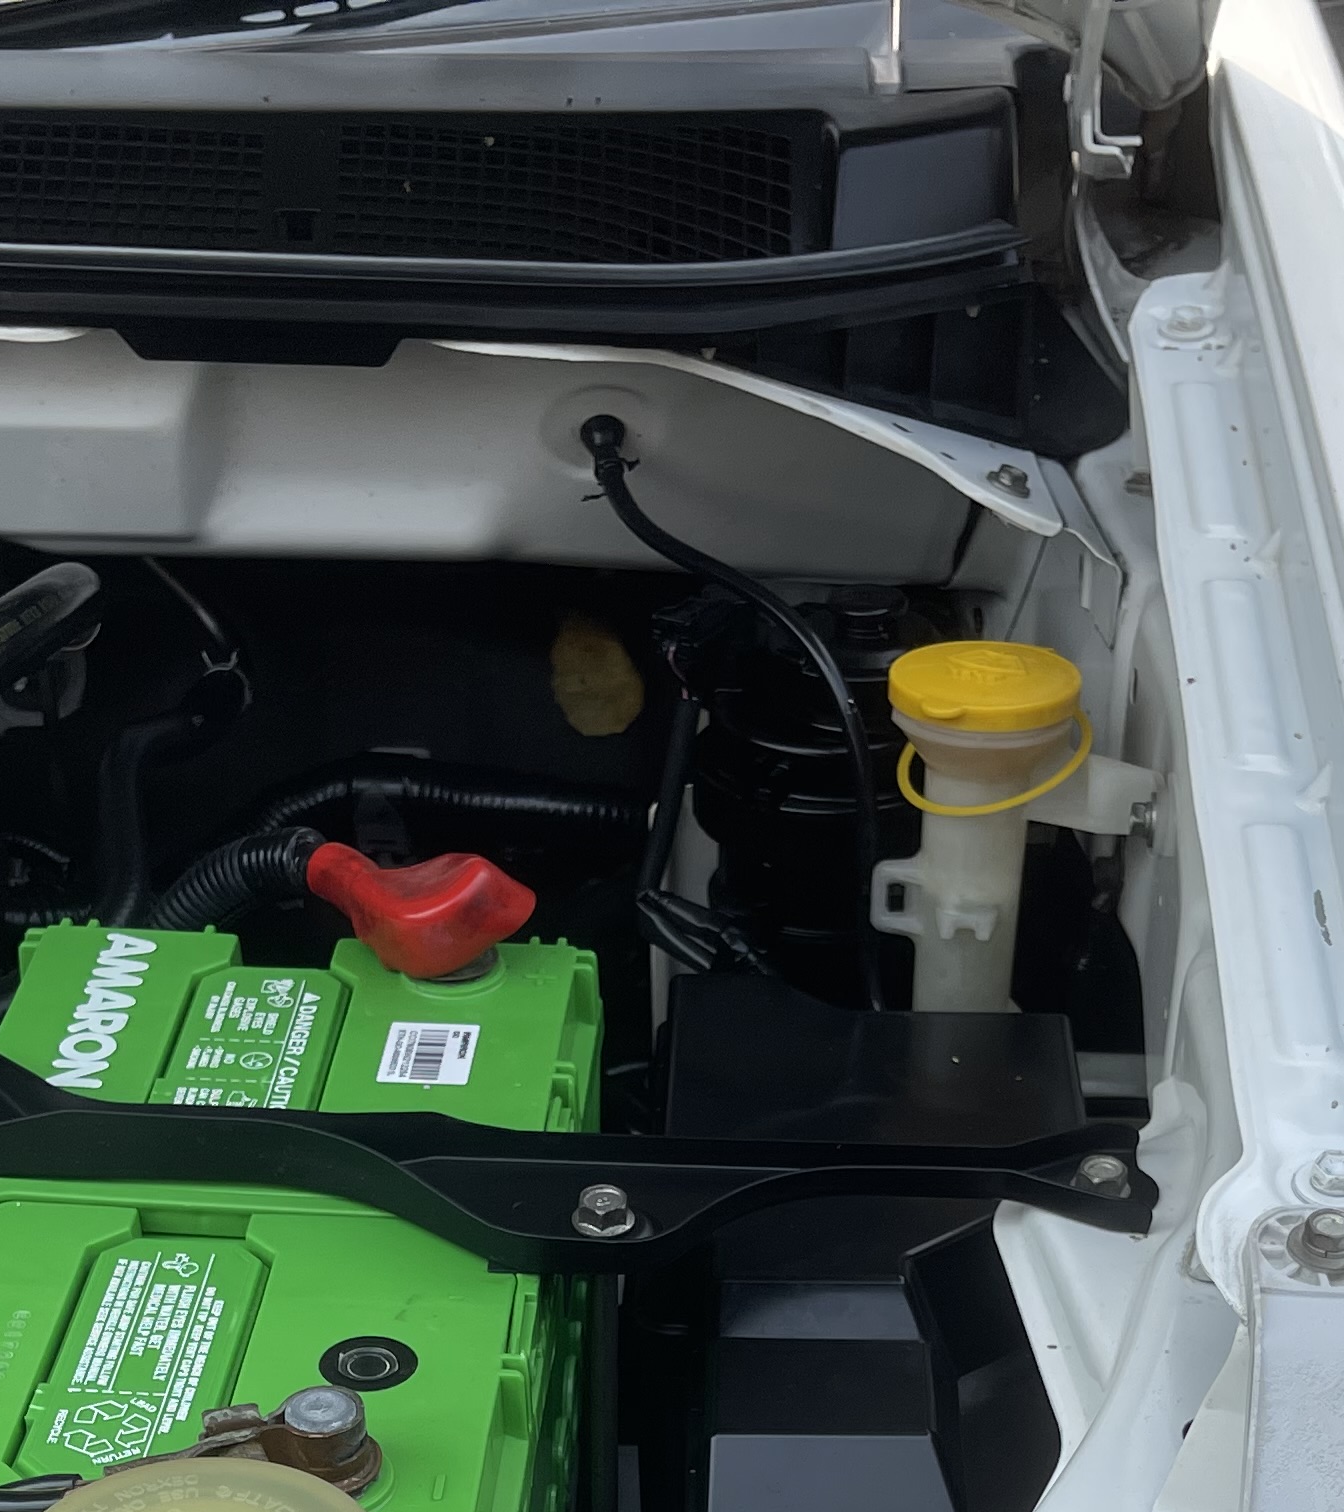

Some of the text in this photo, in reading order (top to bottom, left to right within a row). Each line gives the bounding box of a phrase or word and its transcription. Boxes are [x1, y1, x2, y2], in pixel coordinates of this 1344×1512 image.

[48, 932, 158, 1089] AMARON
[285, 1005, 317, 1055] DANGER
[268, 1066, 298, 1109] CAUTI
[135, 1316, 154, 1336] HELP
[169, 1309, 188, 1329] EYES
[128, 1336, 147, 1356] FAST
[91, 1446, 141, 1465] RETURN
[115, 1473, 199, 1503] DEXRON
[159, 1487, 199, 1502] USE
